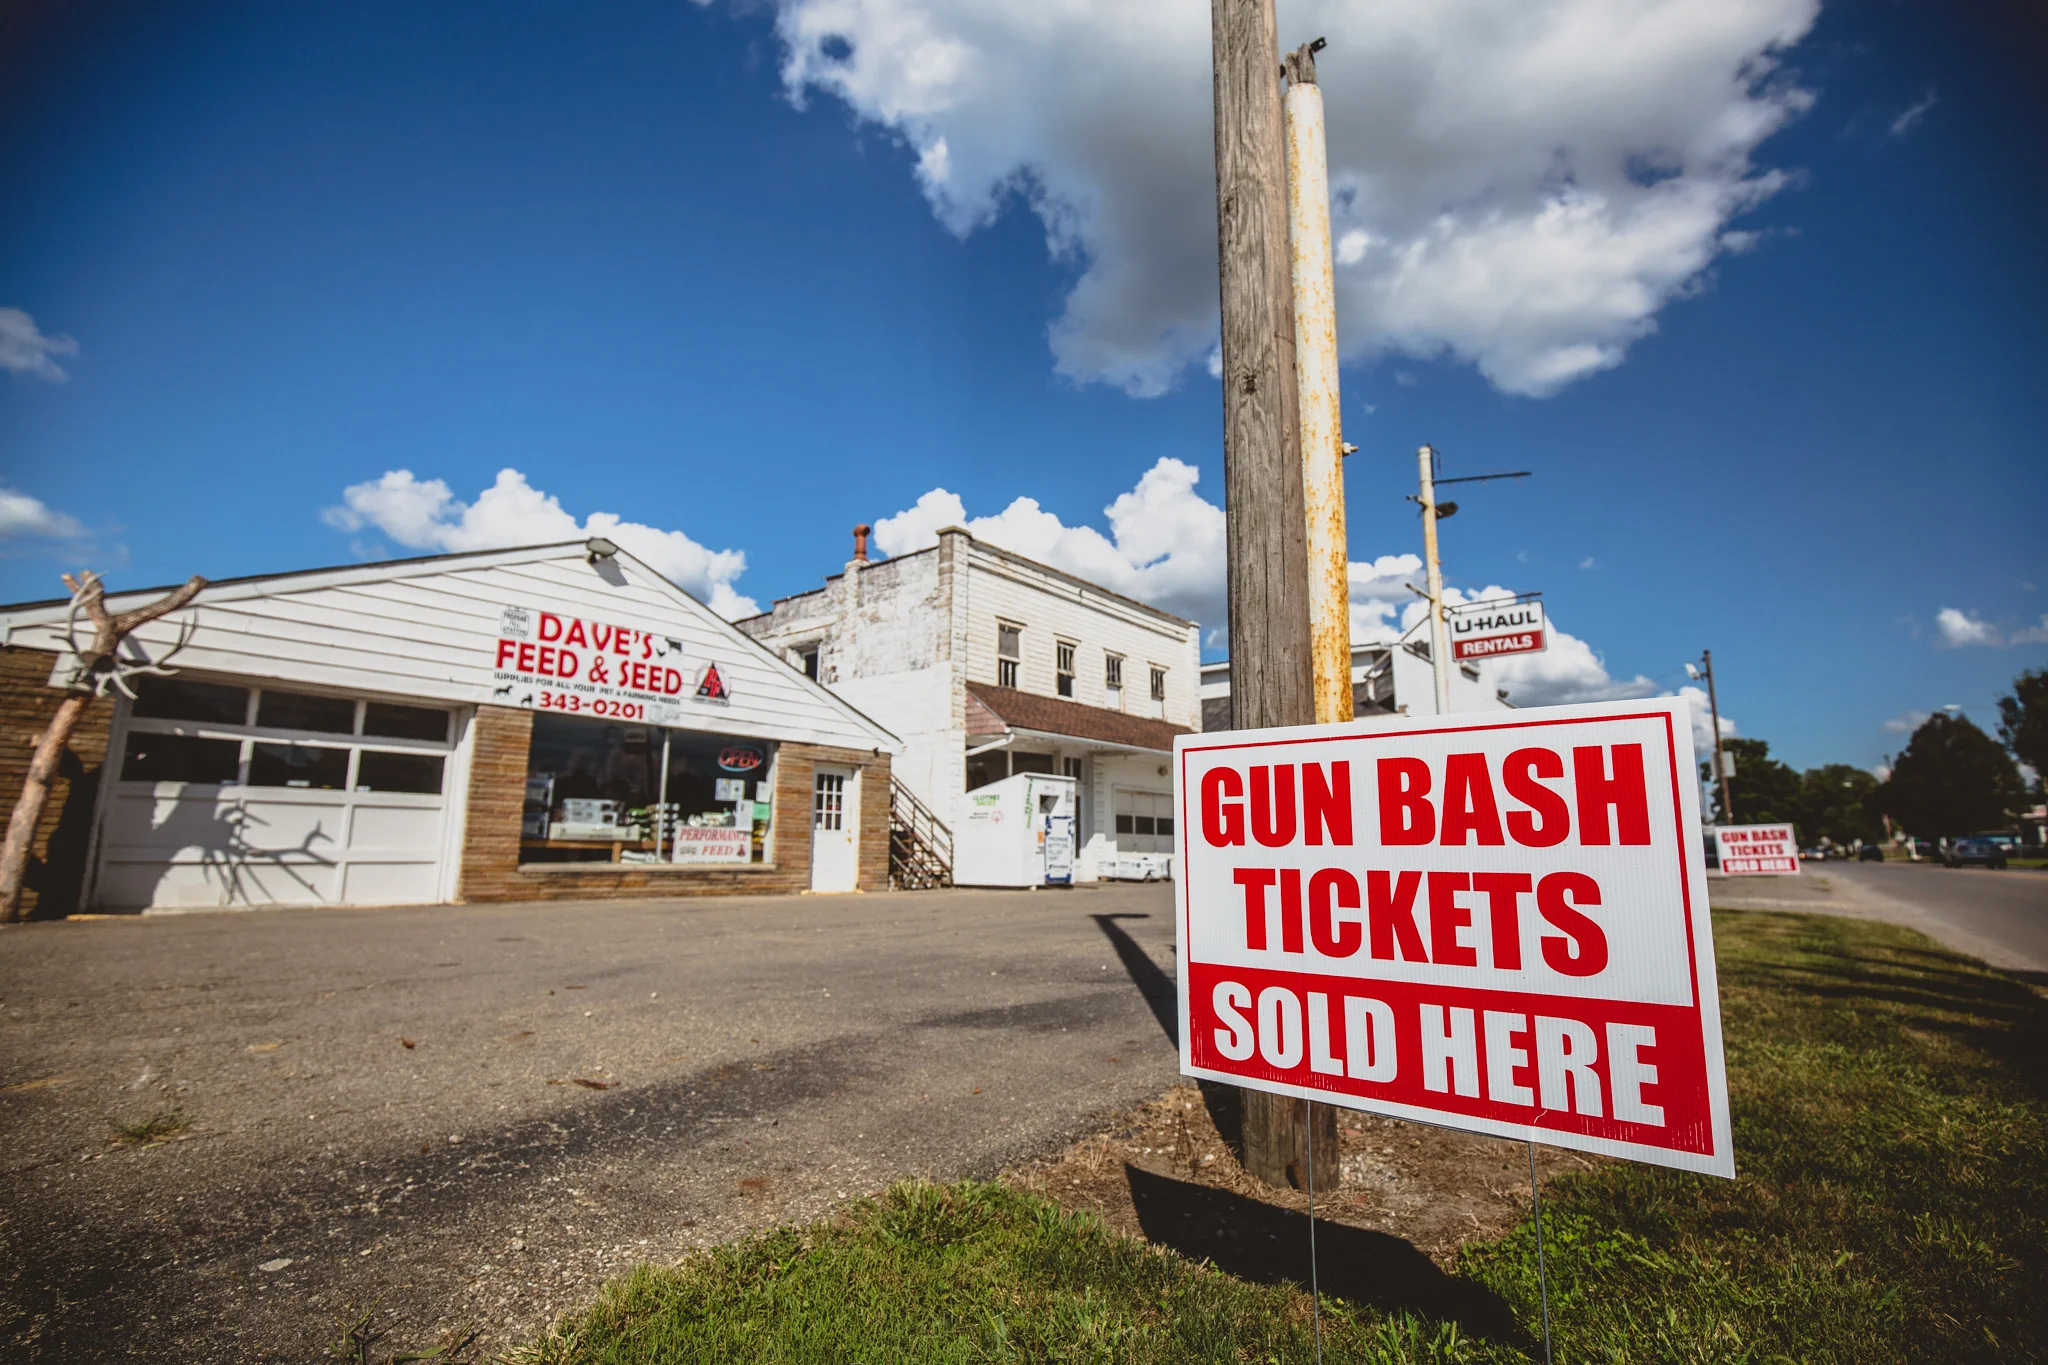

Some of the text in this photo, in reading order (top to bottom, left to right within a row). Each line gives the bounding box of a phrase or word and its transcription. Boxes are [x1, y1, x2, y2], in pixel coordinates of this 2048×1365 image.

[537, 611, 653, 659] DAVE'S
[1455, 611, 1538, 633] U-HAUL
[1462, 634, 1533, 656] RENTALS
[495, 638, 682, 695] FEED & SEED
[494, 672, 533, 684] SUPPLIES
[535, 678, 553, 687] FOR
[556, 681, 570, 689] ALL
[573, 683, 595, 693] YOUR
[600, 687, 613, 695] PET
[623, 691, 658, 702] FARMING
[659, 697, 680, 705] NEEDS
[539, 690, 644, 720] 343-0201
[719, 748, 759, 768] OPEN
[1200, 743, 1651, 848] GUN BASH
[679, 828, 747, 842] PERFORMANCE
[1721, 829, 1788, 842] GUN BASH
[701, 845, 733, 857] FEED
[1729, 844, 1784, 856] TICKETS
[1233, 868, 1609, 977] TICKETS
[1212, 981, 1666, 1127] SOLD HERE
